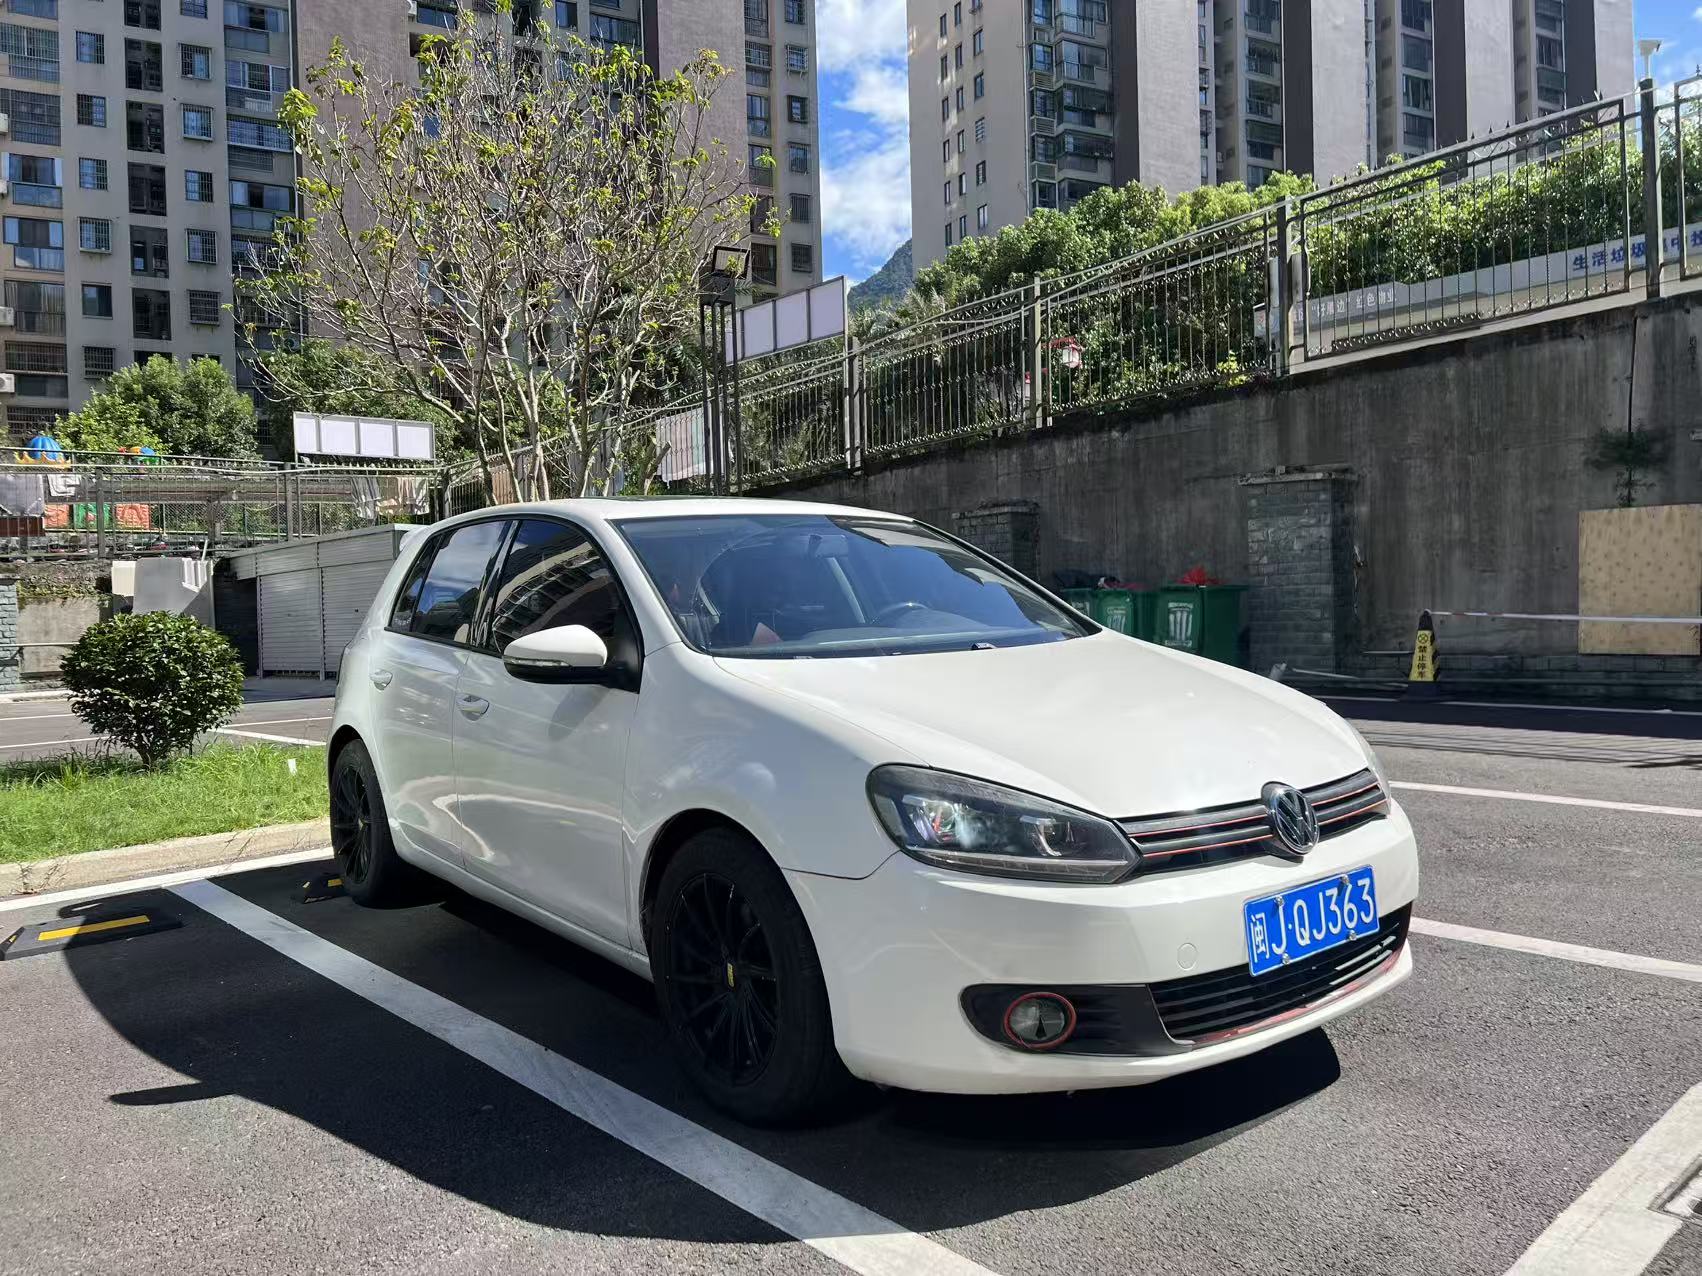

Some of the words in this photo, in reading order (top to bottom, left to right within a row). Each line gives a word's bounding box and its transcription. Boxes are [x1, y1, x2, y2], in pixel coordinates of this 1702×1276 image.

[1573, 231, 1702, 271] 生活垃圾中投
